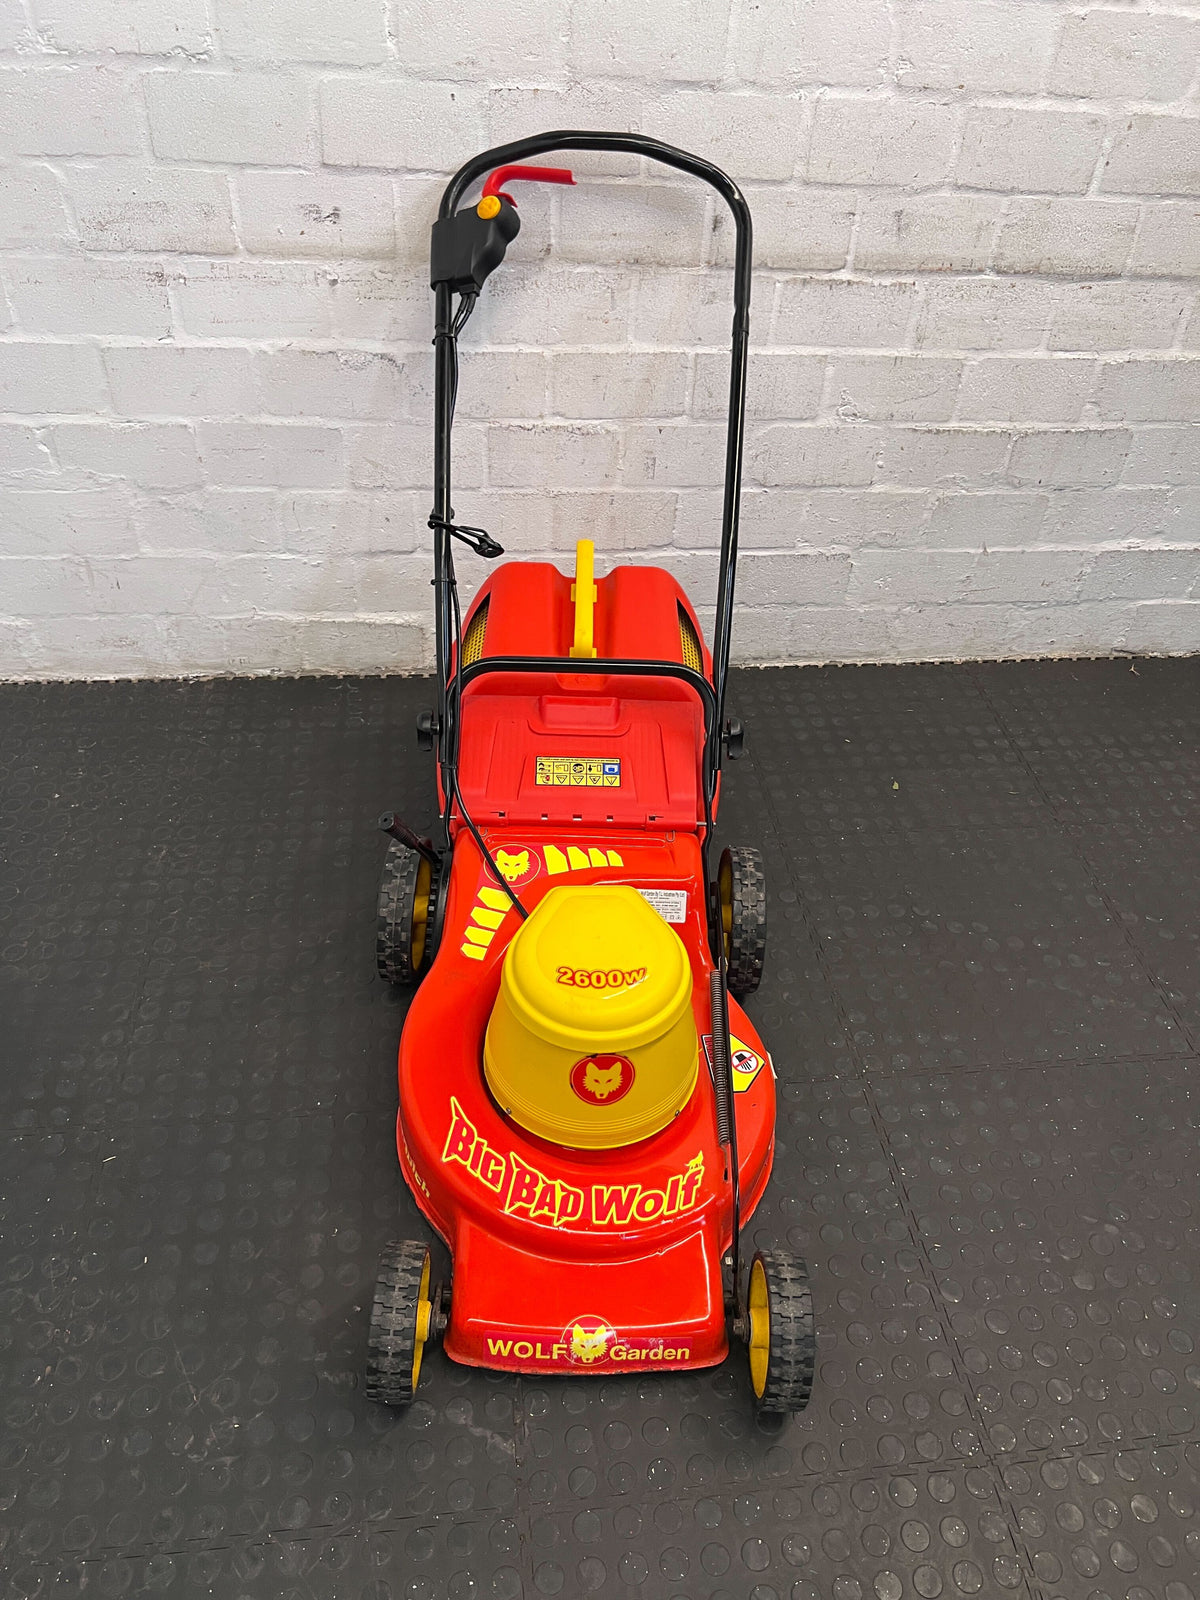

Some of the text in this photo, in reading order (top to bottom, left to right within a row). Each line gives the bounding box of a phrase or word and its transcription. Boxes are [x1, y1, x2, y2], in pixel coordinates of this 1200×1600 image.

[441, 1096, 705, 1227] BIG BAD Wolf
[487, 1338, 690, 1361] WOLF Garden
